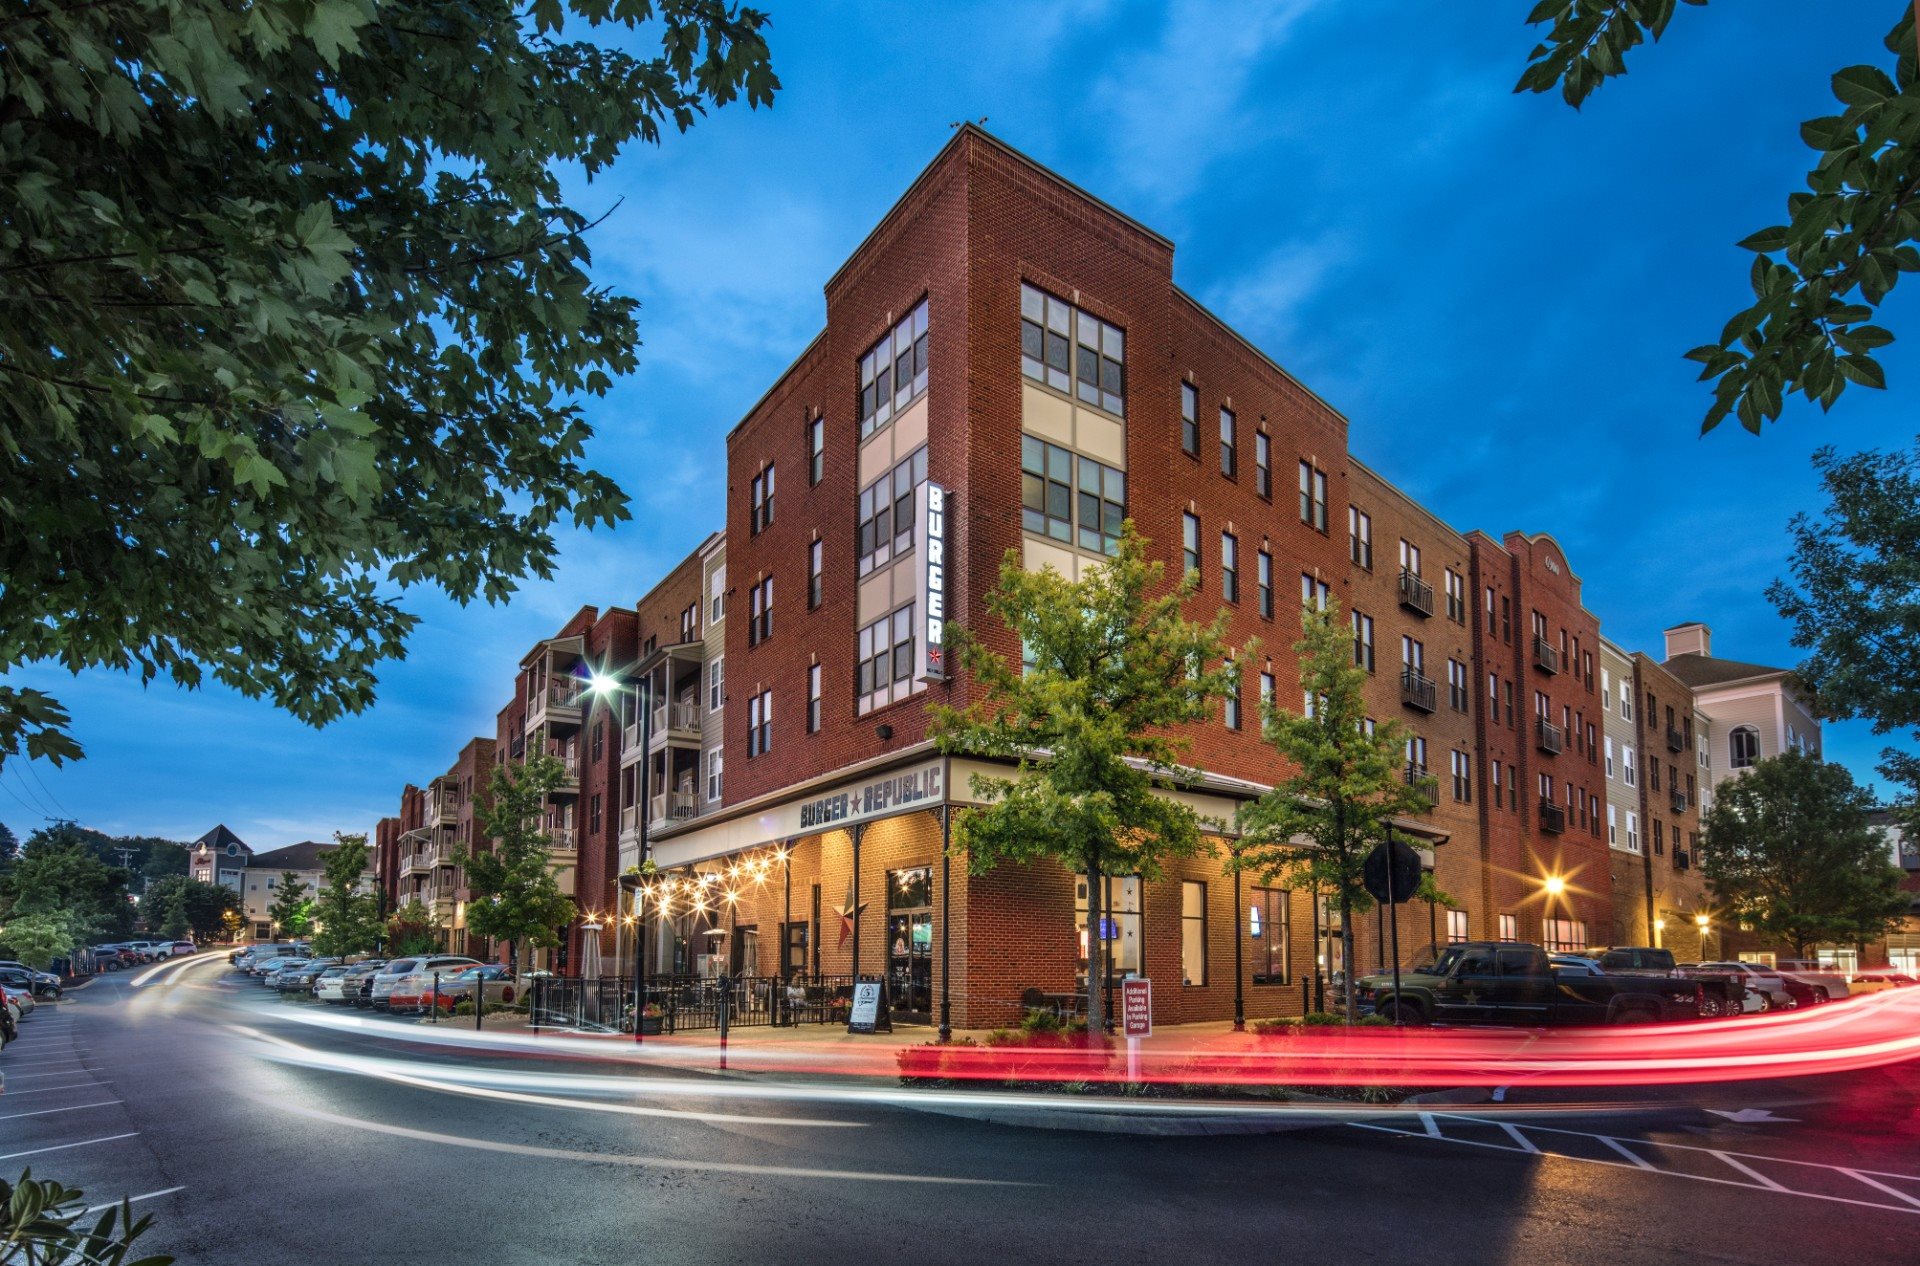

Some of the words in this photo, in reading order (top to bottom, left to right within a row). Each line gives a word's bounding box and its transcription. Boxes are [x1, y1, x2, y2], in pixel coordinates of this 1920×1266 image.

[928, 485, 943, 644] BURGER
[800, 793, 849, 829] BURGER
[863, 766, 941, 814] REPUBLIC
